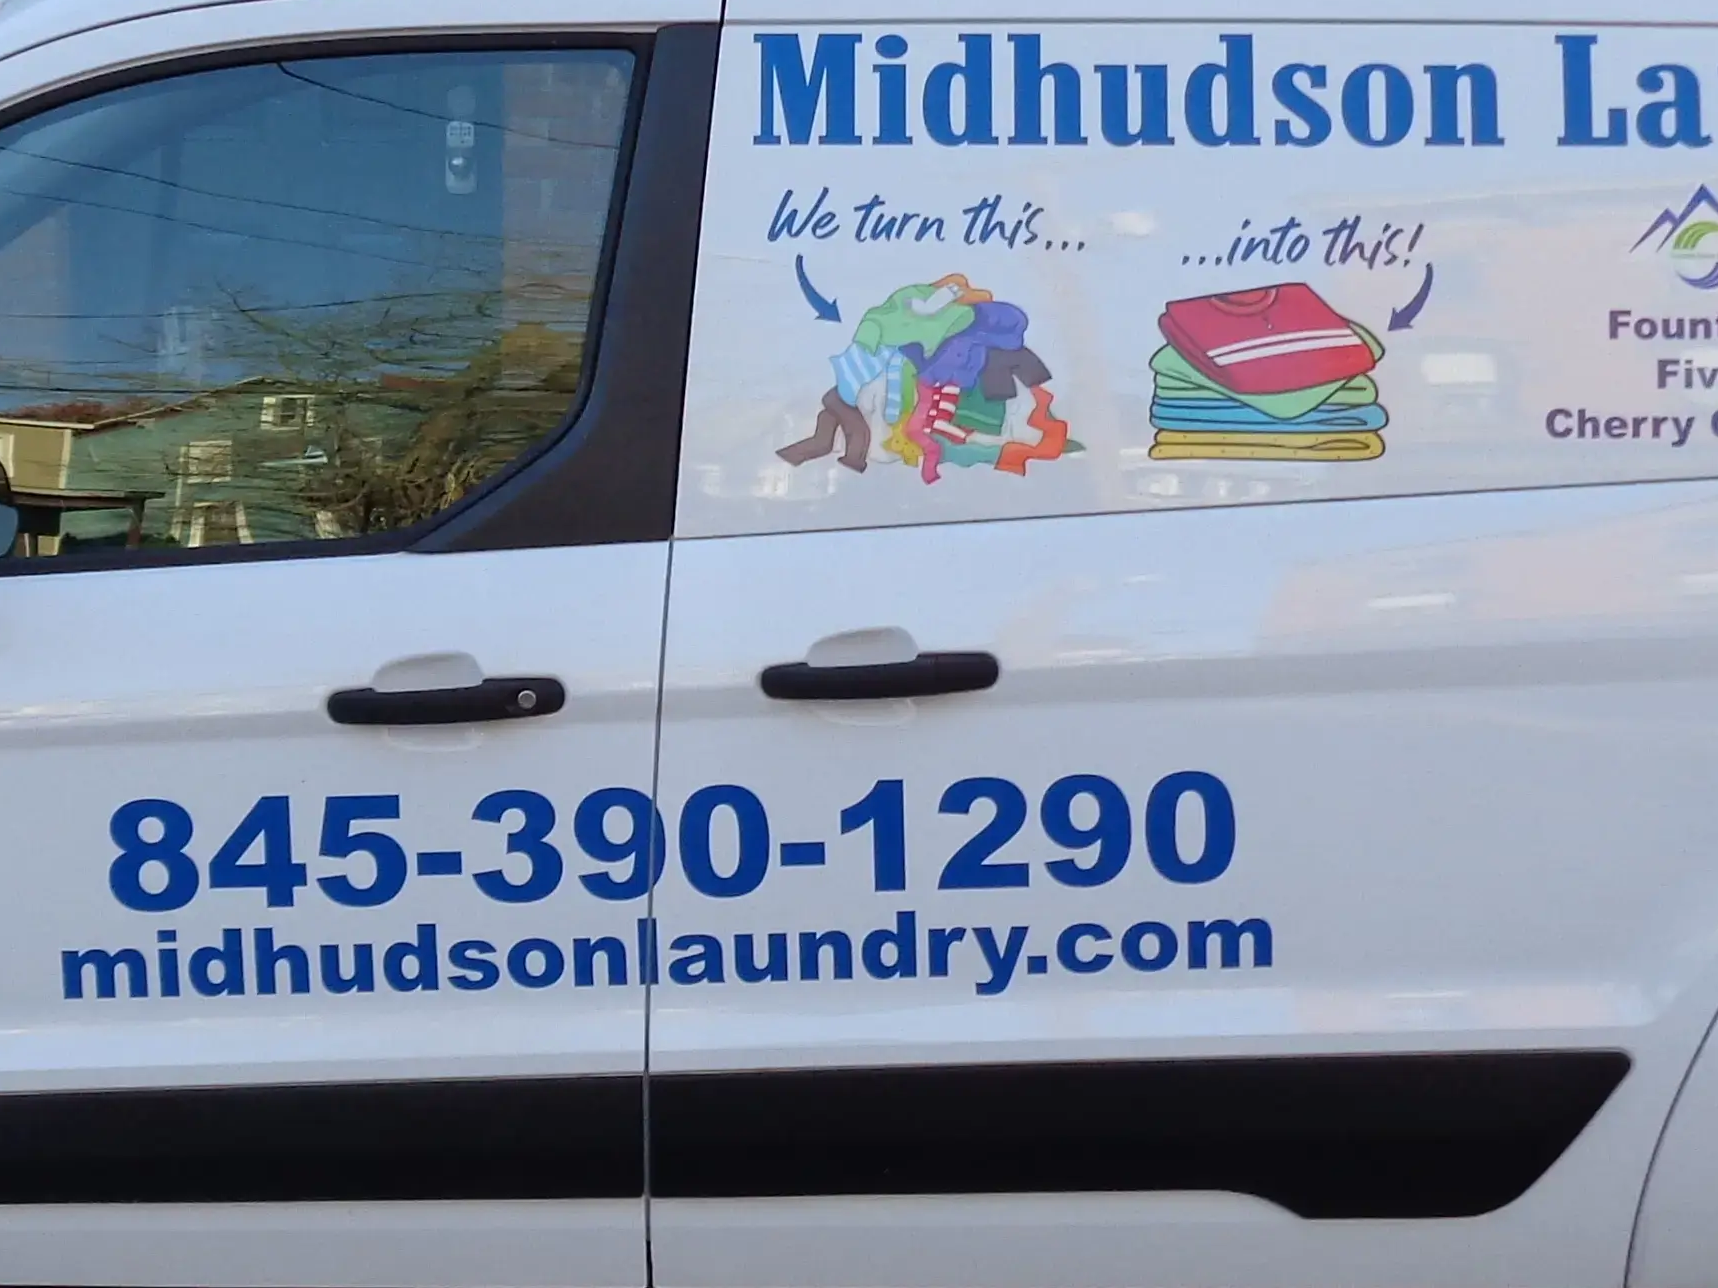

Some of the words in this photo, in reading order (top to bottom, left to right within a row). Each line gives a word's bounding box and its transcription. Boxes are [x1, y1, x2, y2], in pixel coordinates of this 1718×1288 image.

[753, 33, 1505, 147] Midhudson
[767, 186, 841, 242] We
[853, 194, 946, 243] turn
[961, 193, 1086, 251] this...
[1322, 214, 1426, 271] this!
[1544, 408, 1695, 447] Cherry
[106, 769, 1237, 914] 845-390-1290
[59, 909, 1275, 1003] midhudsonlaundry.com
